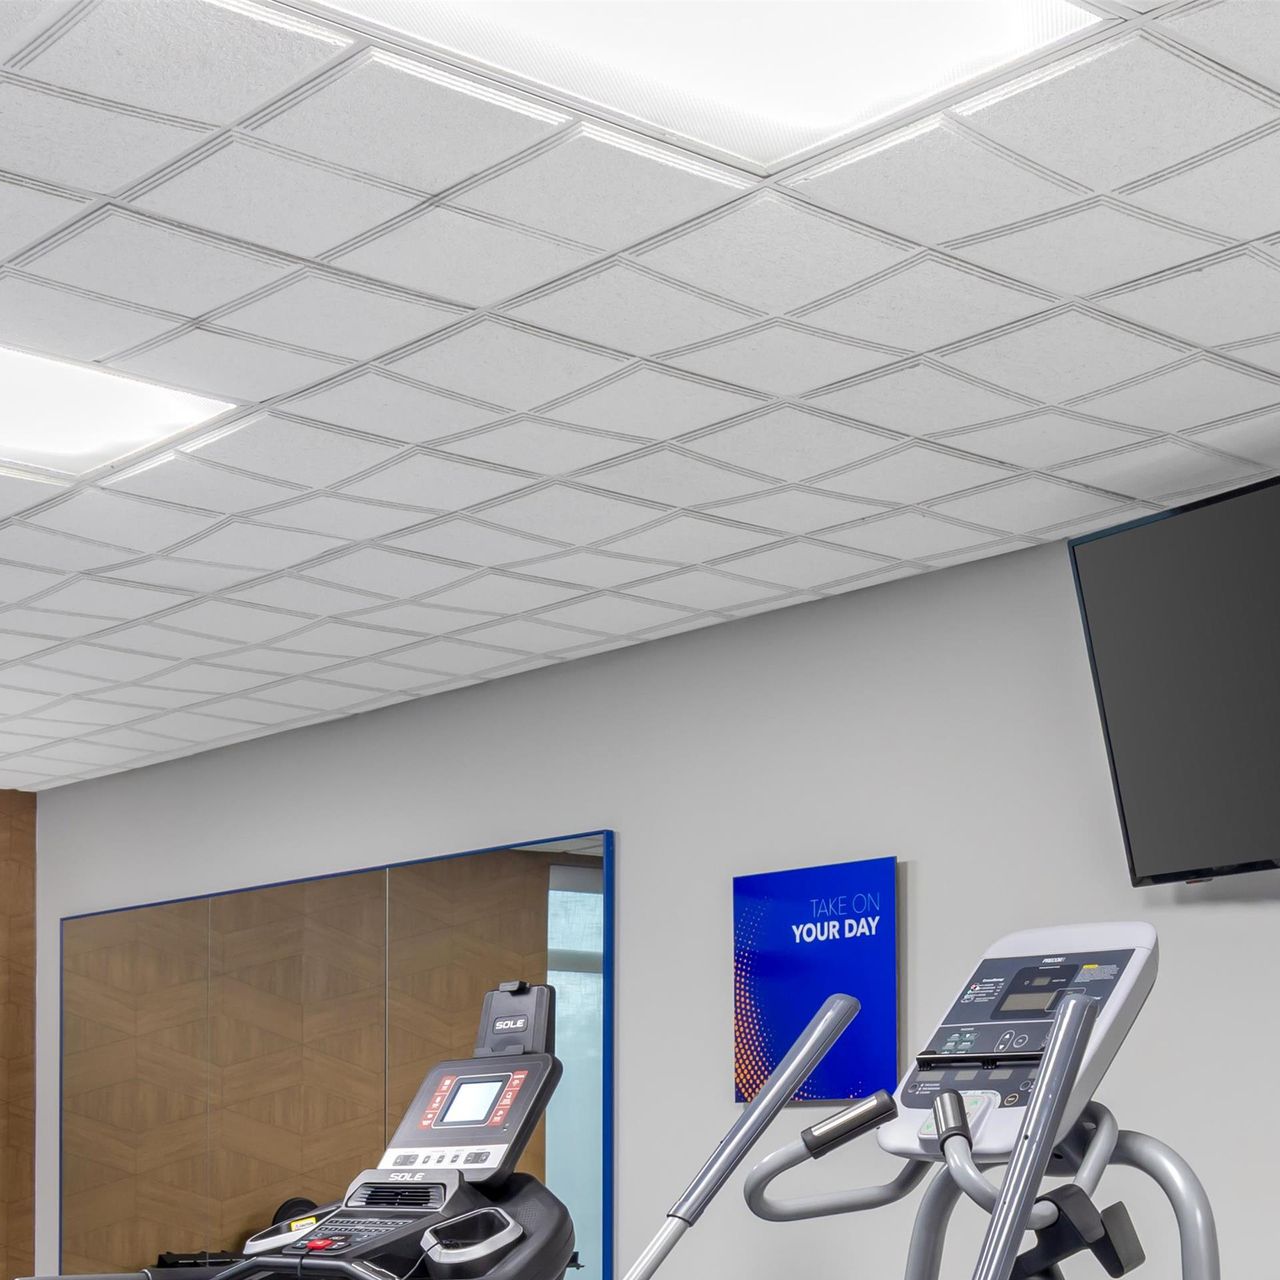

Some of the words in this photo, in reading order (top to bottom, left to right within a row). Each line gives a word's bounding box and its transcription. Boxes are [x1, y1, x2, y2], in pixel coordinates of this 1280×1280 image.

[810, 896, 848, 918] TAKE
[852, 892, 880, 914] ON
[791, 920, 840, 943] YOUR
[844, 915, 880, 938] DAY
[495, 1019, 525, 1030] SOLE
[388, 1172, 425, 1181] SOLE
